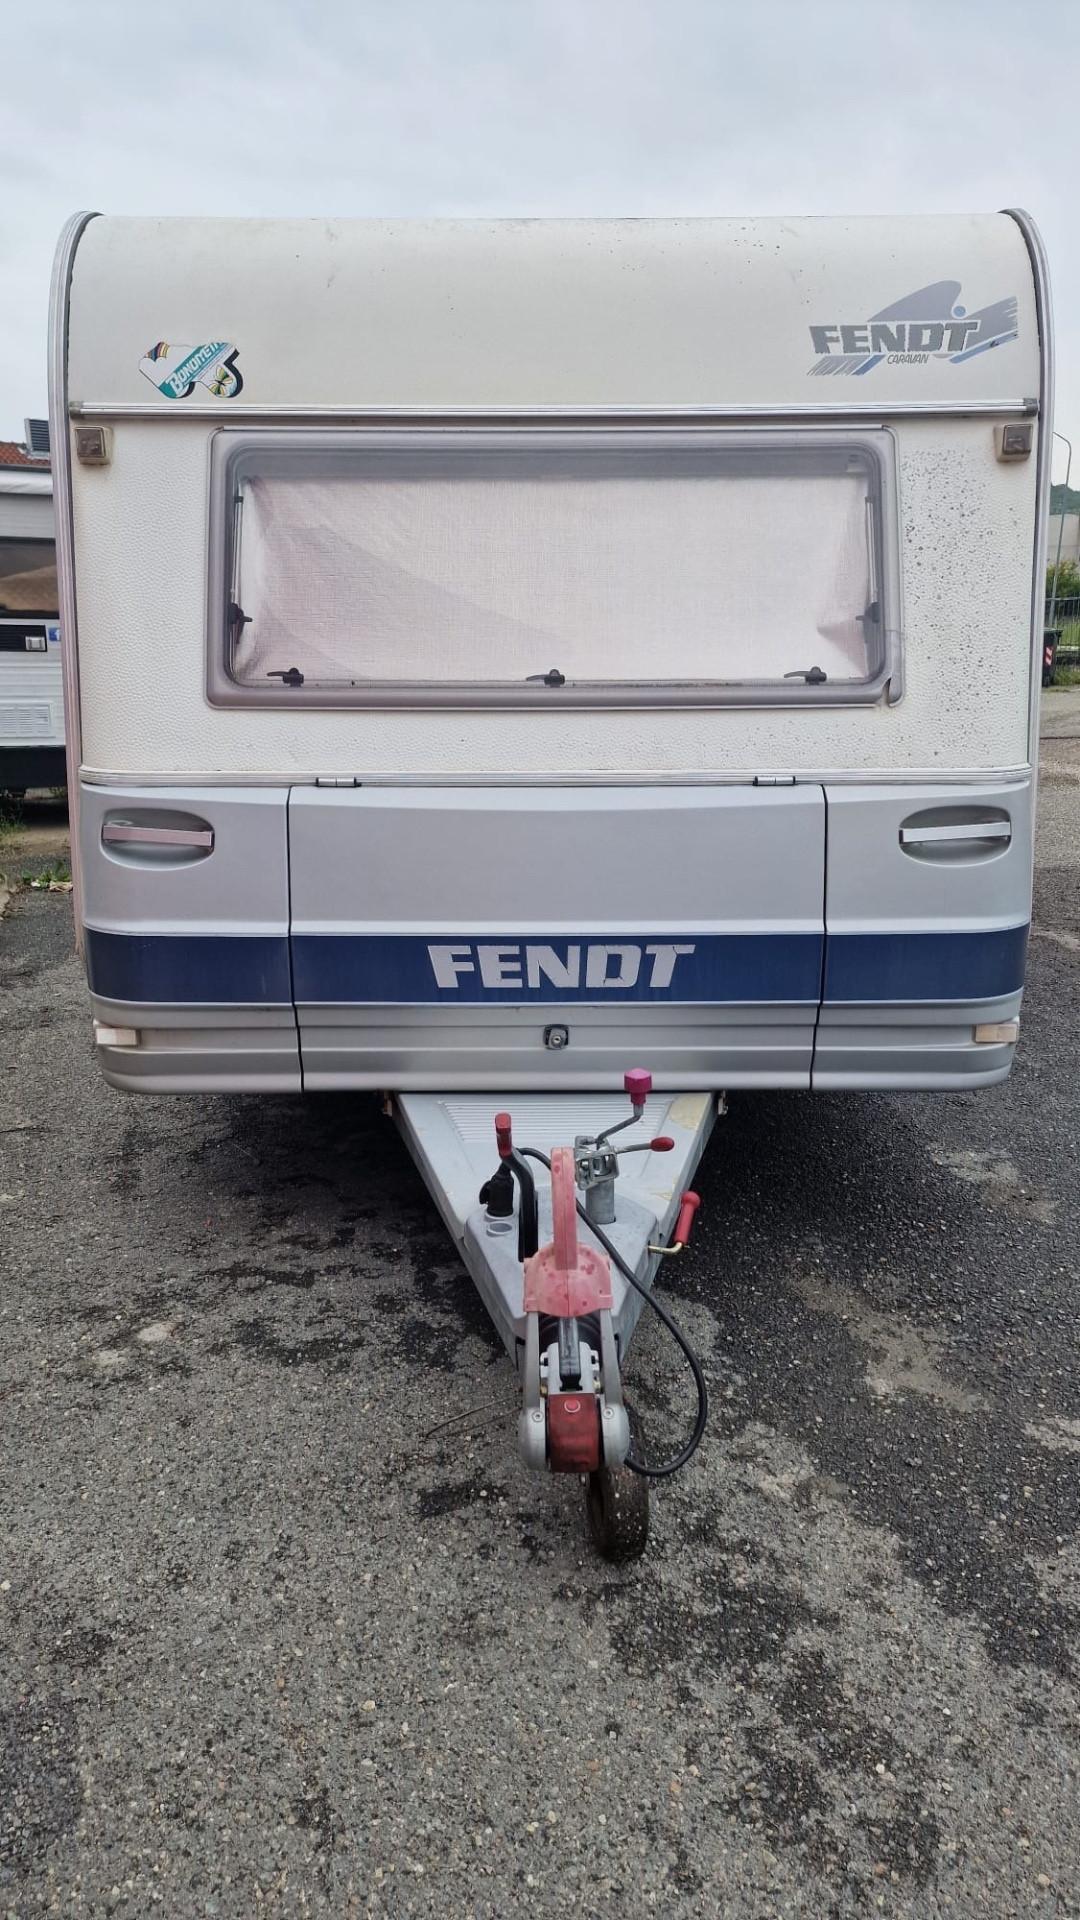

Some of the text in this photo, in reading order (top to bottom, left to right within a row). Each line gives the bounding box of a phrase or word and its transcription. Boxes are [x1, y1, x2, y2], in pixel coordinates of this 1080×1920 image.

[809, 322, 978, 354] FENDT
[887, 353, 929, 365] CARAVAN
[427, 944, 696, 988] FENDT
